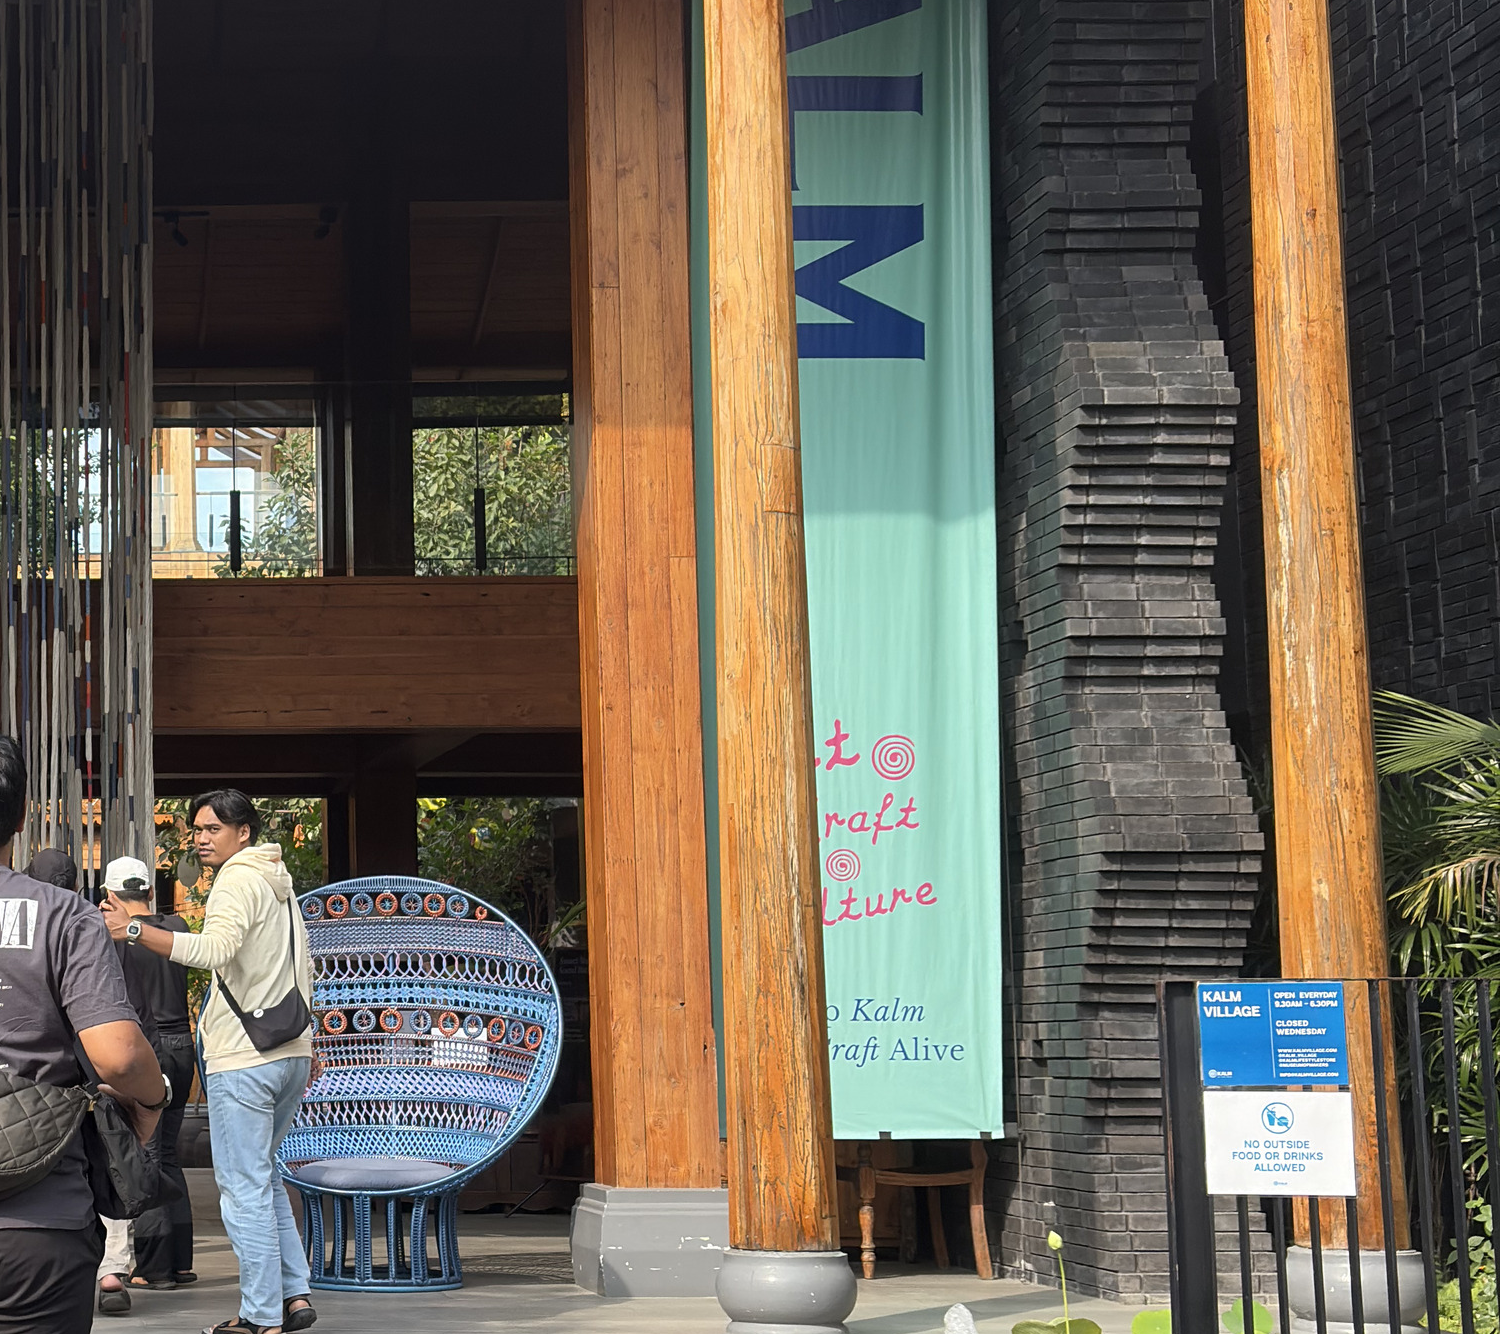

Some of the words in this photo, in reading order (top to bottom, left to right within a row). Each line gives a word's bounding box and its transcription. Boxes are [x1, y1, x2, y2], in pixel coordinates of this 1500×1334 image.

[817, 793, 919, 845] raft
[822, 882, 937, 926] lture
[1202, 990, 1242, 1002] KALM
[1299, 991, 1337, 999] EVERYDAY
[850, 997, 925, 1022] Kalm
[1203, 1006, 1261, 1017] VILLAGE
[1276, 1028, 1327, 1036] WEDNESDAY
[828, 1036, 880, 1068] raft
[889, 1037, 965, 1061] Alive
[1244, 1140, 1260, 1148] NO
[1263, 1140, 1310, 1149] OUTSIDE
[1232, 1151, 1261, 1160] FOOD
[1264, 1151, 1280, 1160] OR
[1283, 1152, 1324, 1161] DRINKS
[1254, 1163, 1306, 1172] ALLOWED
